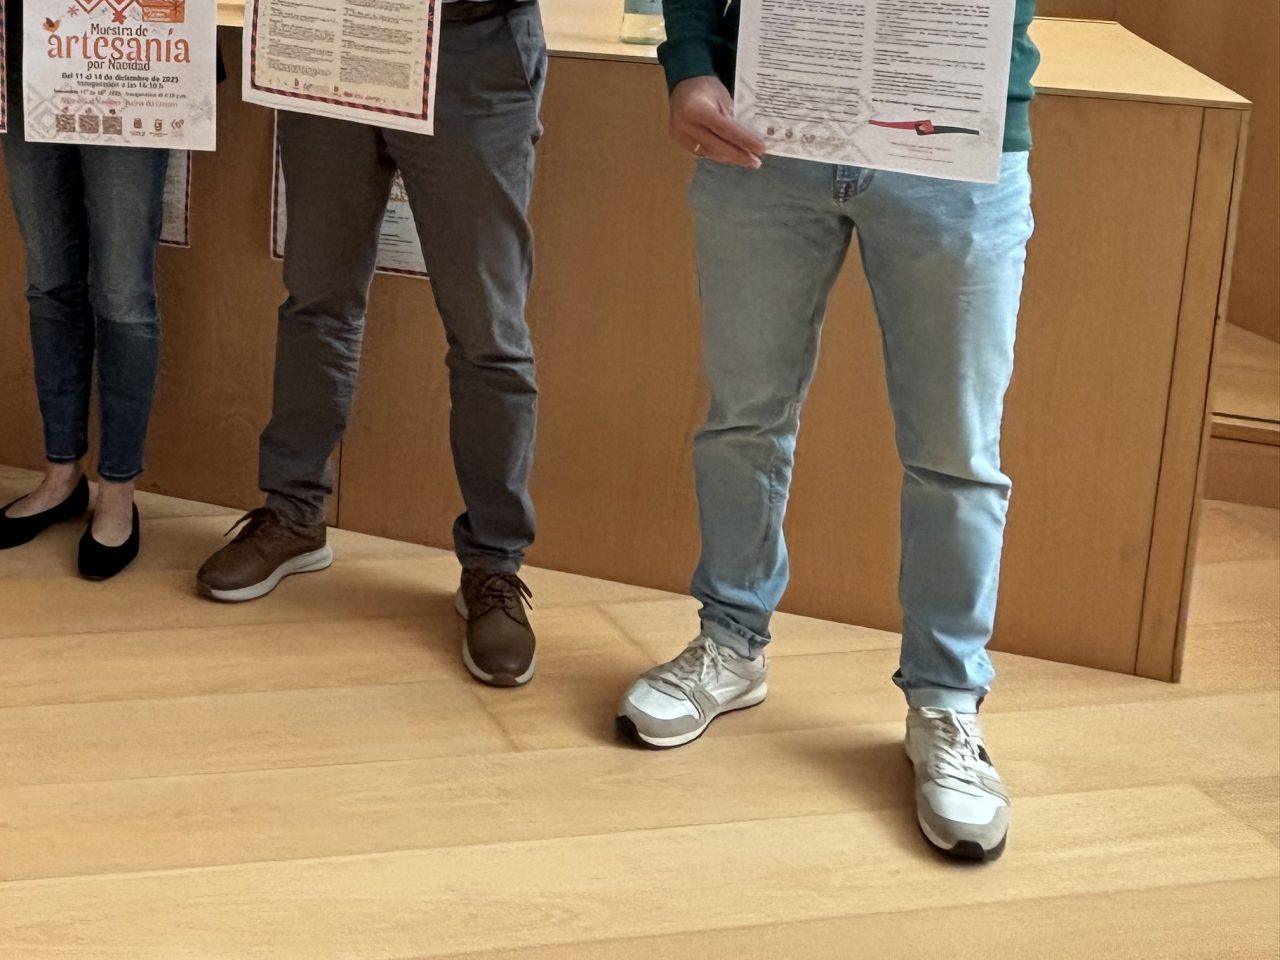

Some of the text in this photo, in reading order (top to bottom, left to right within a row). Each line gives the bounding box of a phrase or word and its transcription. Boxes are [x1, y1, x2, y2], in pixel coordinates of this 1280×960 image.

[90, 23, 149, 37] Muestra de
[46, 28, 191, 64] artesanía
[87, 58, 151, 72] por Navidad
